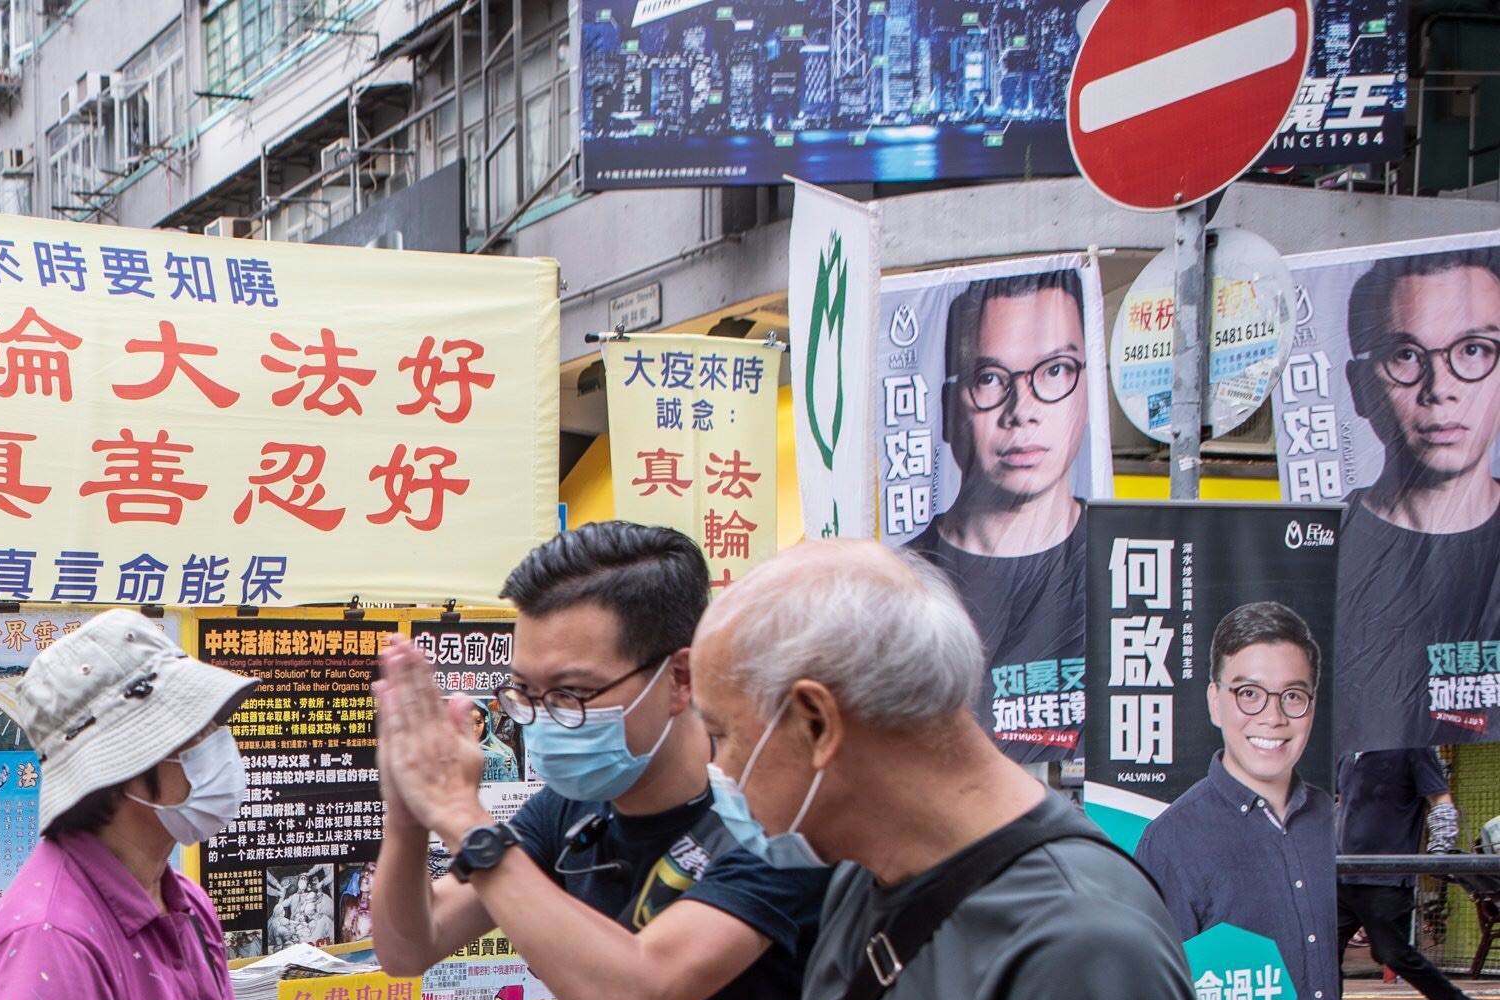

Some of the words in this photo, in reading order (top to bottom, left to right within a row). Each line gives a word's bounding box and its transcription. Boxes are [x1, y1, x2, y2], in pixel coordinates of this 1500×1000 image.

[1215, 327, 1242, 347] 5481
[1246, 321, 1275, 343] 6114
[1124, 344, 1150, 362] 5481
[1152, 341, 1172, 358] 611
[623, 350, 765, 395] 大疫來時
[631, 448, 694, 497] 真
[1108, 537, 1175, 764] 何啟明
[276, 684, 292, 692] and
[293, 683, 312, 692] Take
[313, 682, 330, 691] their
[331, 682, 360, 693] Organs
[361, 682, 369, 690] to
[1117, 773, 1151, 783] KALVIN
[1152, 773, 1166, 782] HO
